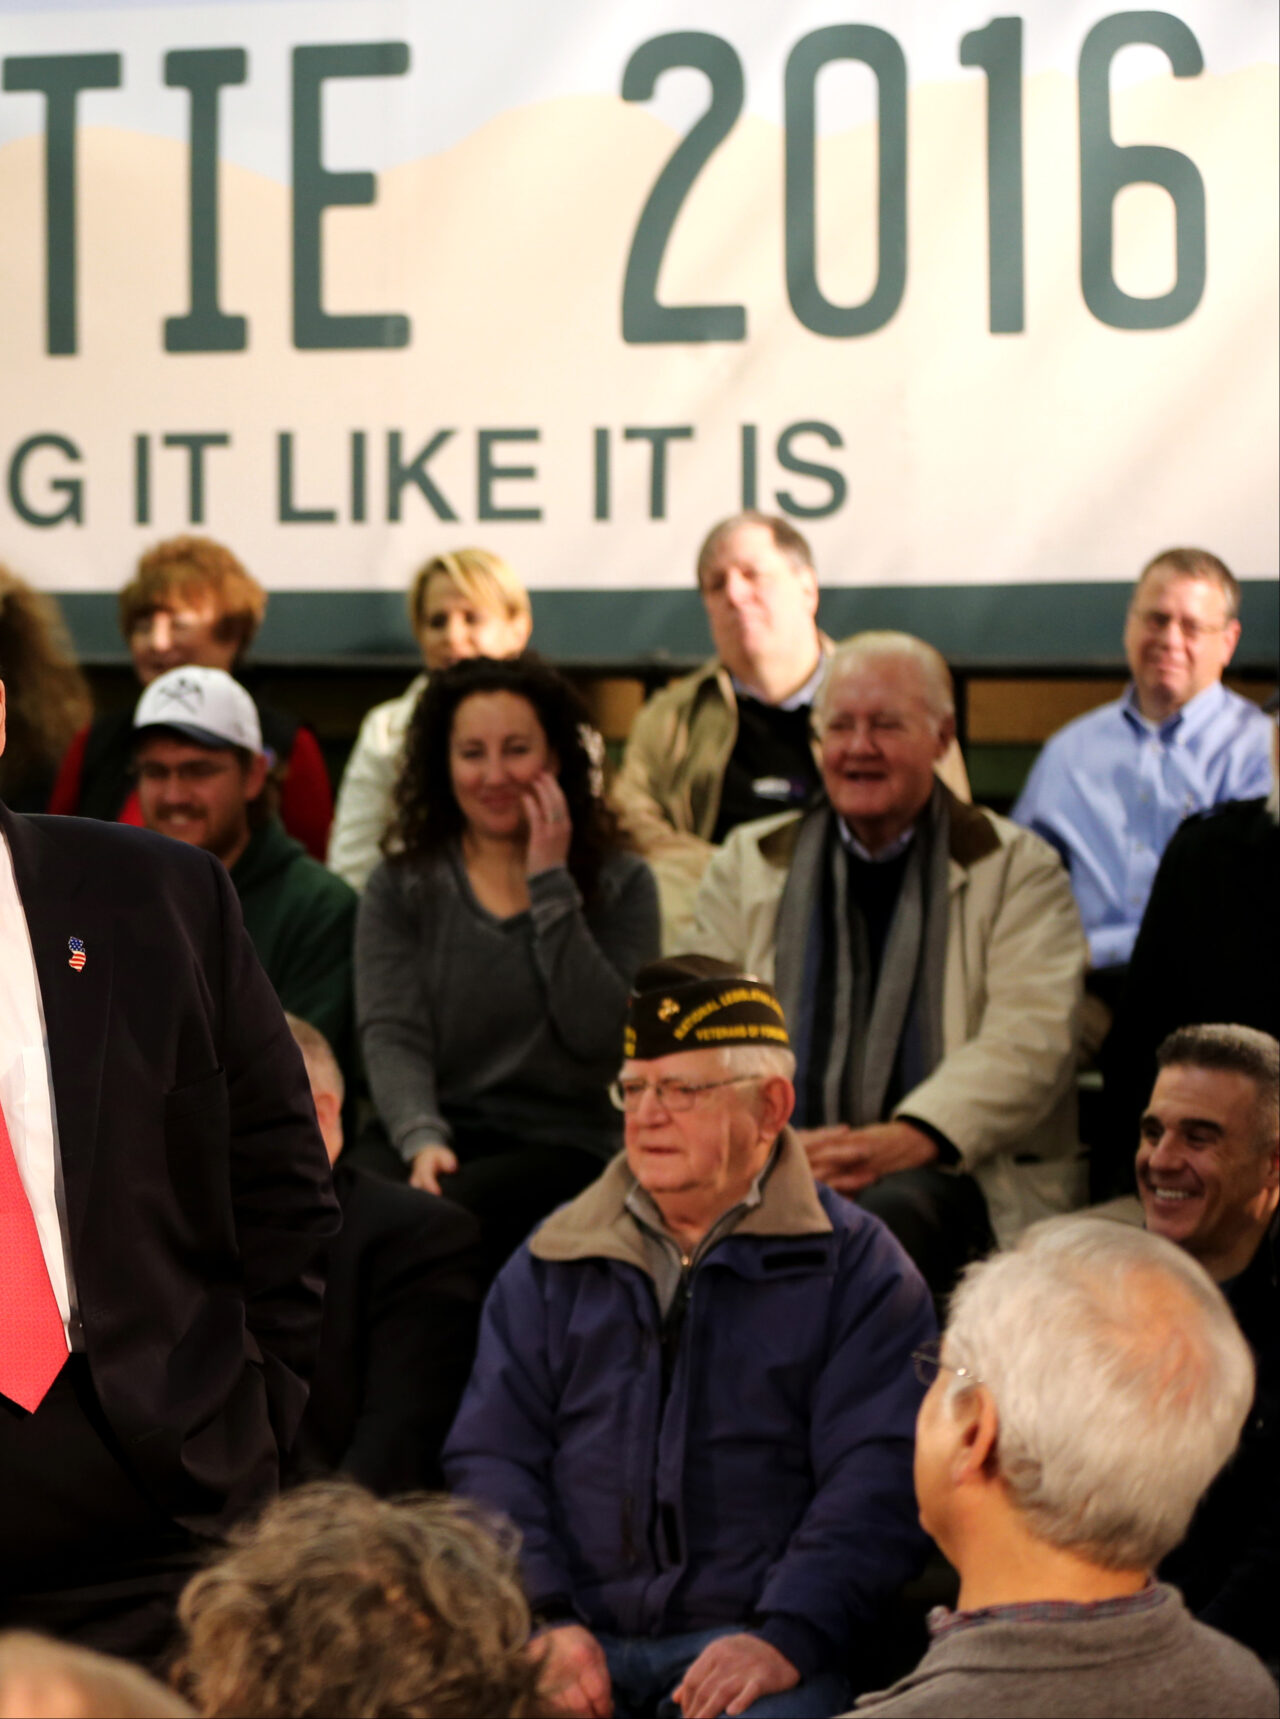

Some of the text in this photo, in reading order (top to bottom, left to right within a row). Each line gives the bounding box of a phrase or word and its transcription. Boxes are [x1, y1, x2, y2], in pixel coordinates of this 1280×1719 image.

[622, 11, 1205, 343] 2016
[135, 433, 231, 525] IT
[278, 430, 542, 524] LIKE
[595, 427, 694, 520] IT
[741, 421, 849, 519] IS
